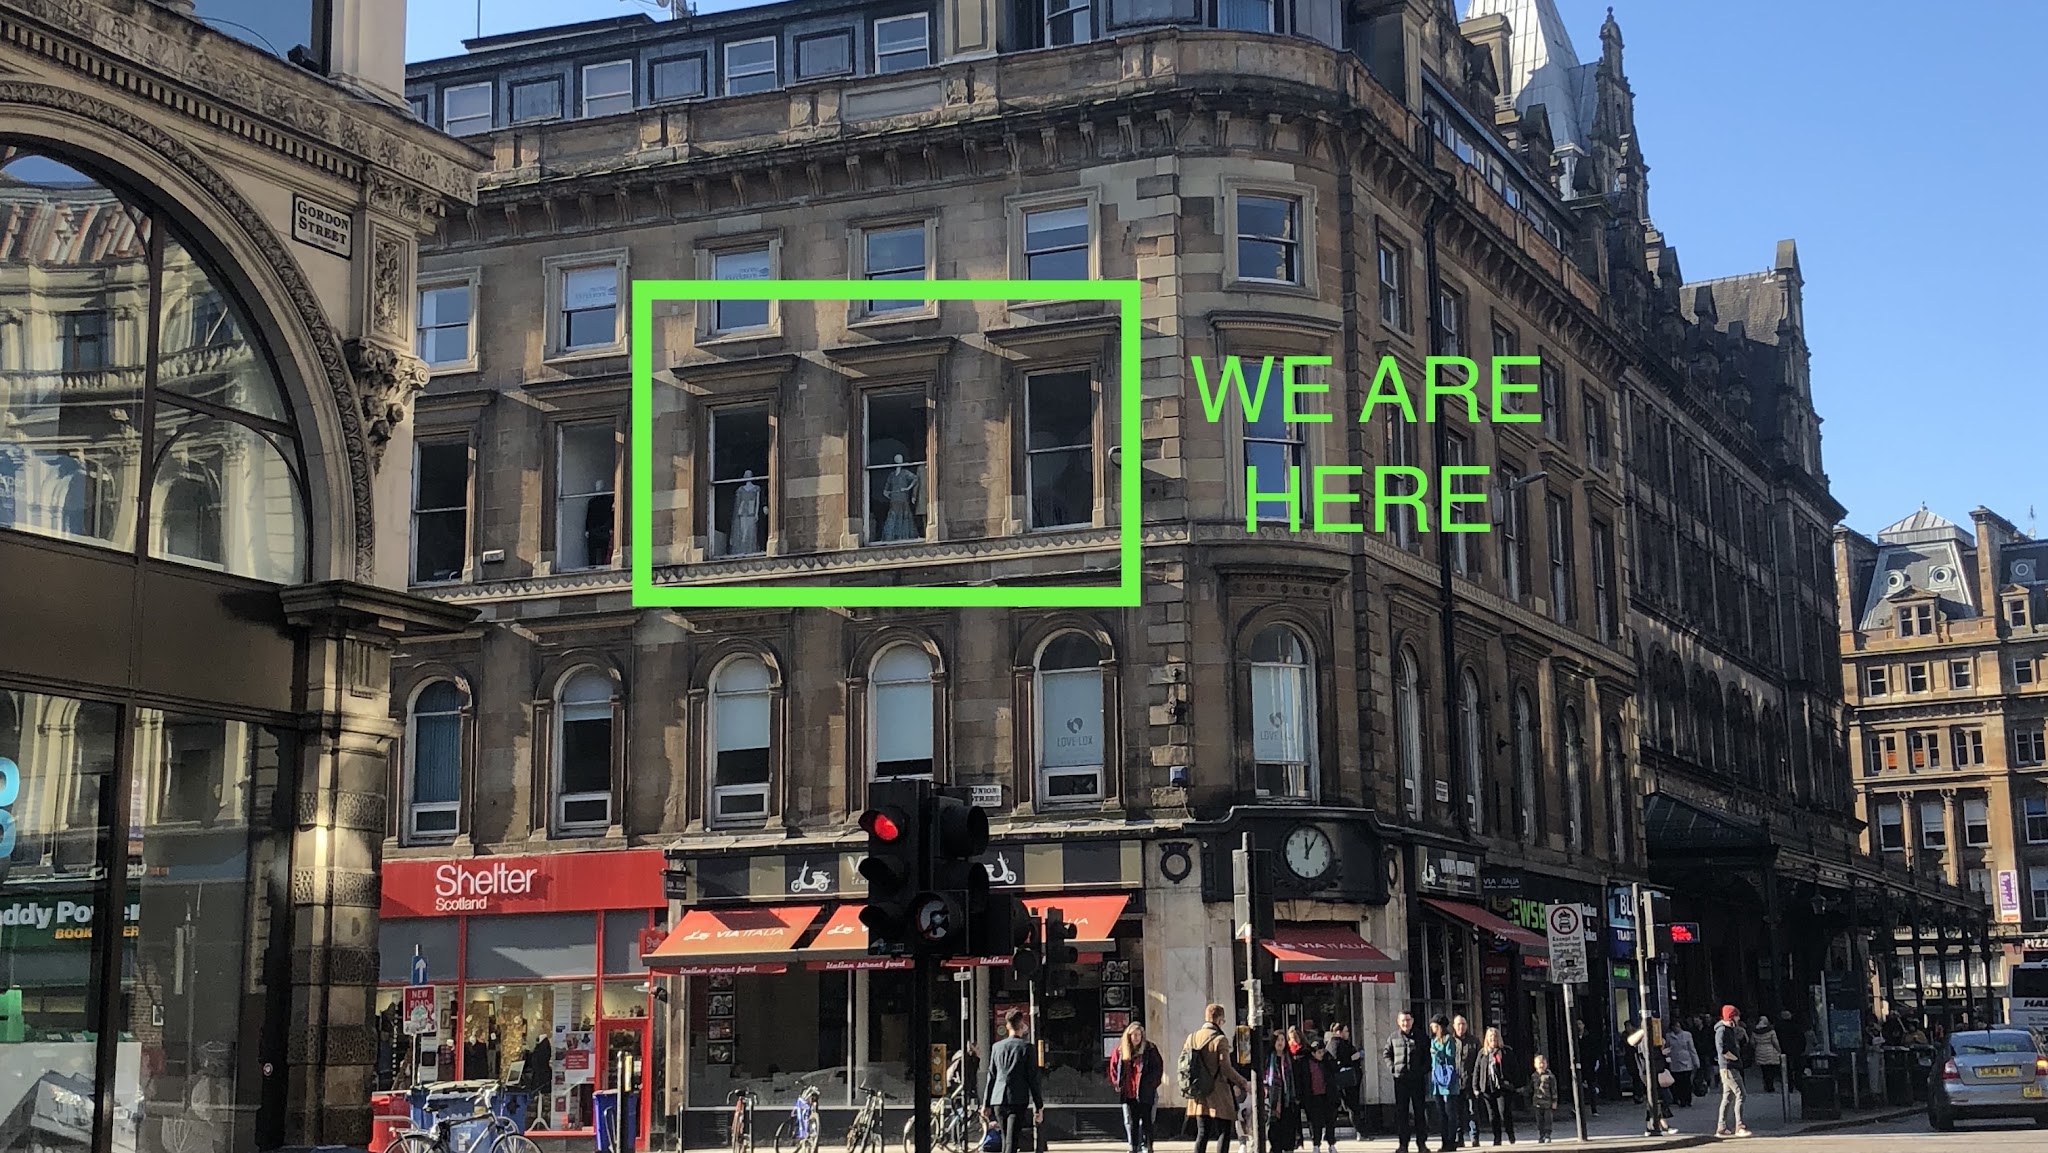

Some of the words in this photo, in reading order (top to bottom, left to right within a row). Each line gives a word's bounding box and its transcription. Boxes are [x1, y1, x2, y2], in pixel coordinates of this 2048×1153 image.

[297, 201, 349, 231] GORDON
[299, 216, 347, 245] STREET
[435, 862, 538, 897] Shelter
[435, 896, 488, 911] Scotland
[716, 930, 740, 938] VIA
[743, 928, 784, 937] ITALIA
[411, 989, 429, 999] NEW
